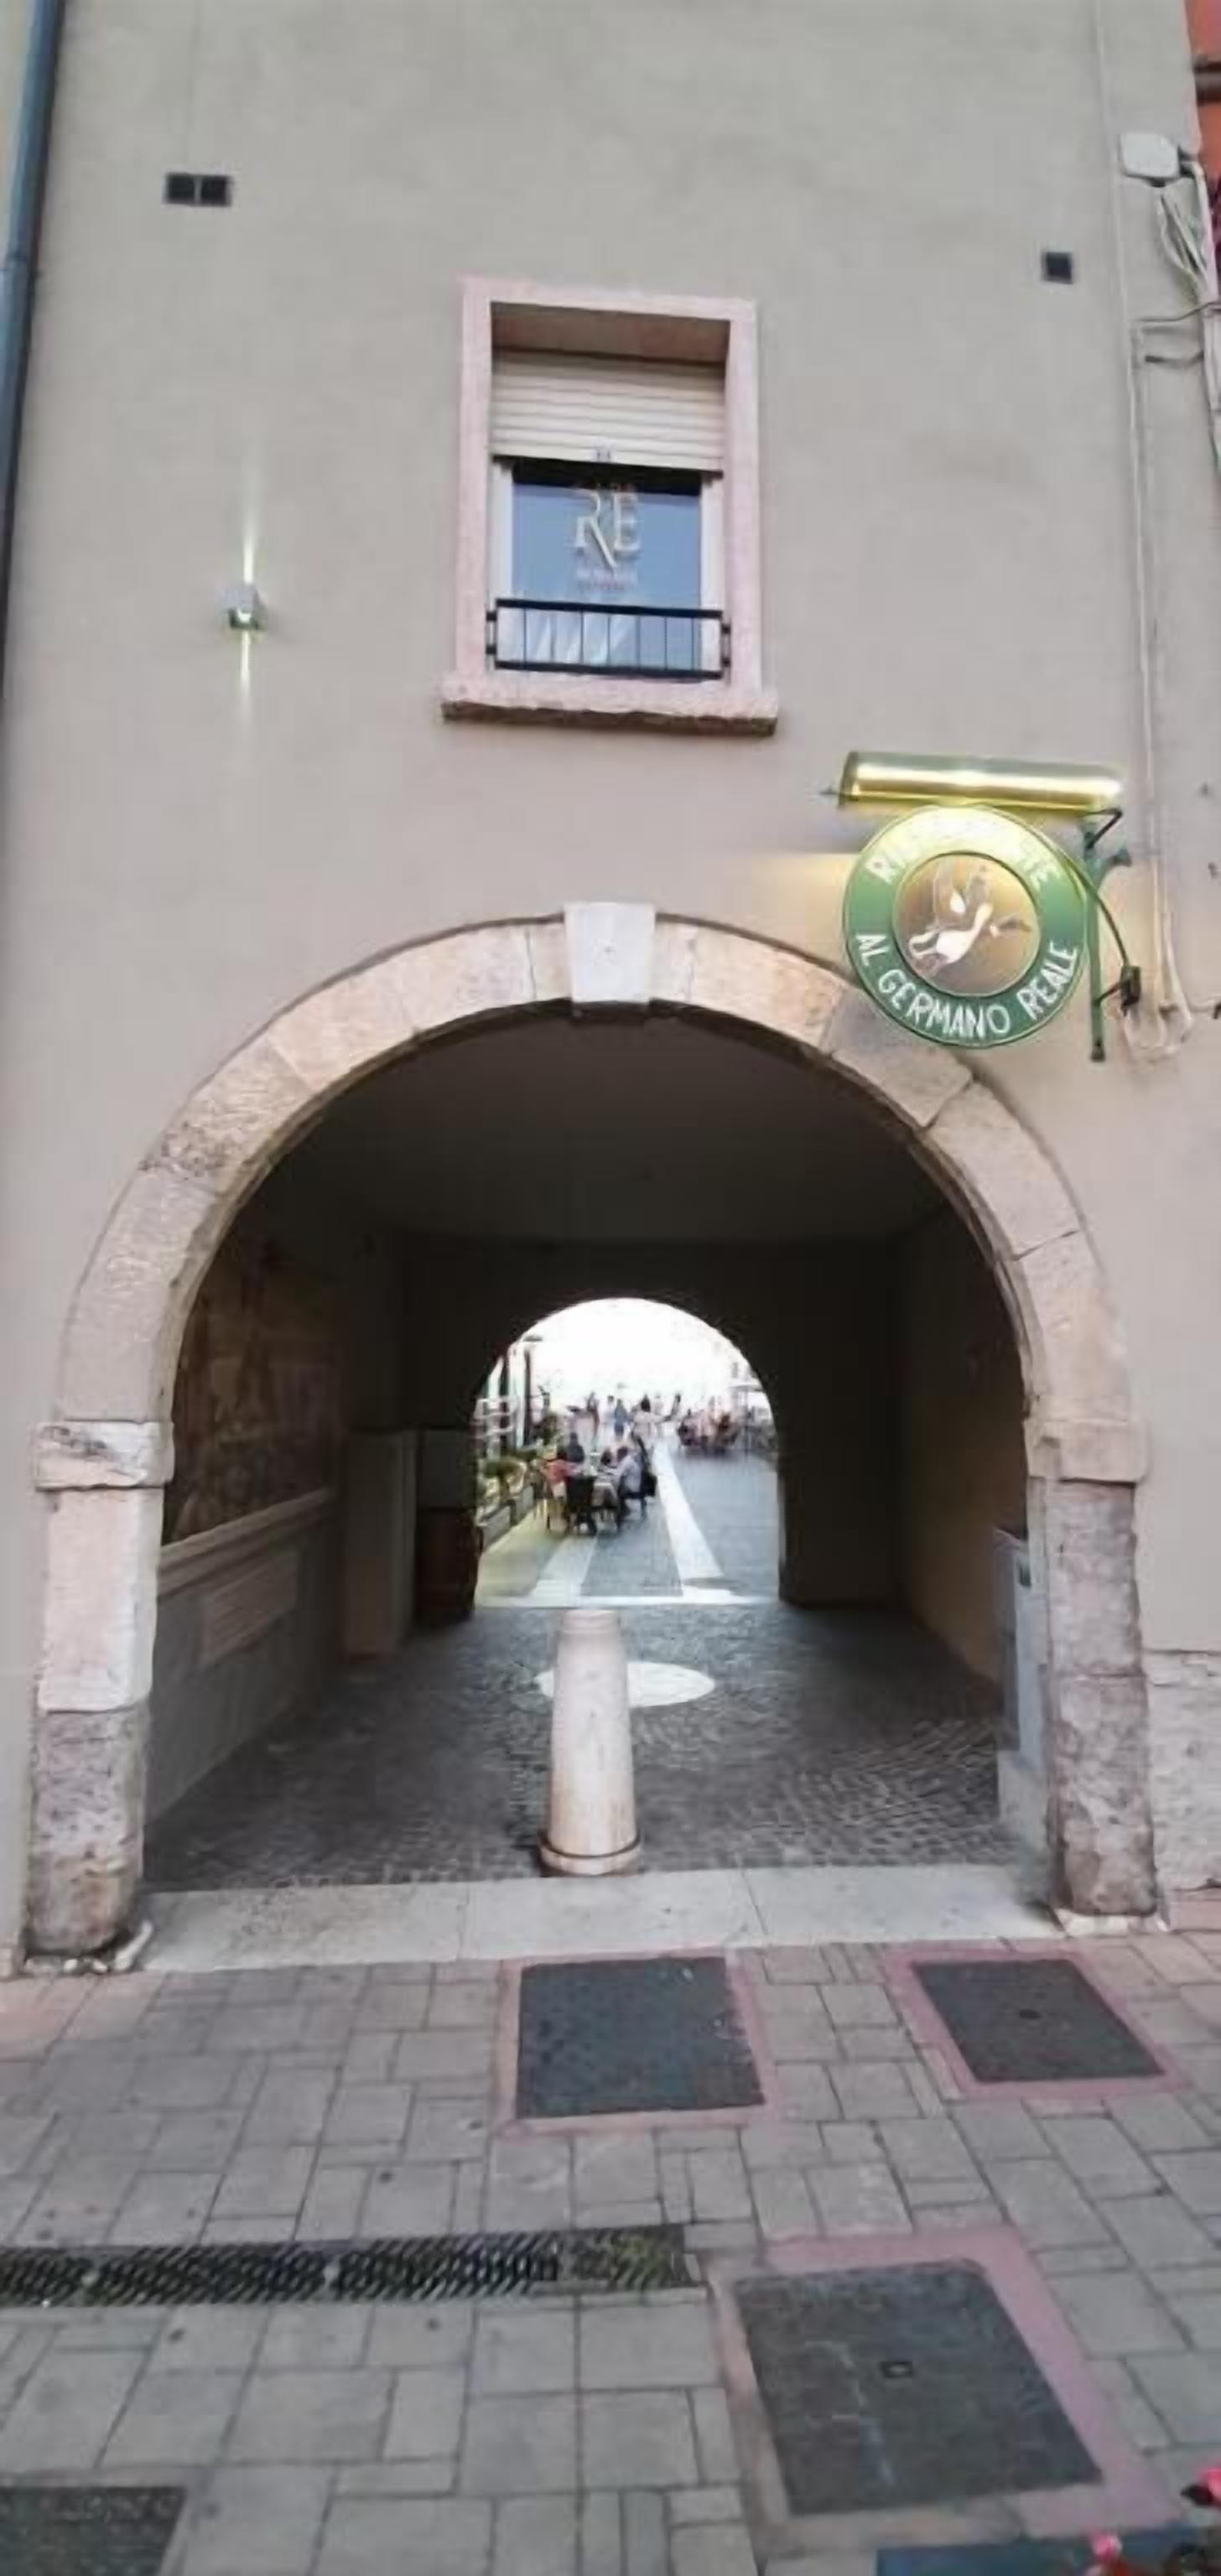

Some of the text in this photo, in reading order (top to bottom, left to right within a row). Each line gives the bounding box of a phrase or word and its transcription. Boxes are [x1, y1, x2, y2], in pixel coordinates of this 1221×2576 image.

[855, 933, 1078, 1038] AL GERMANO REALE
